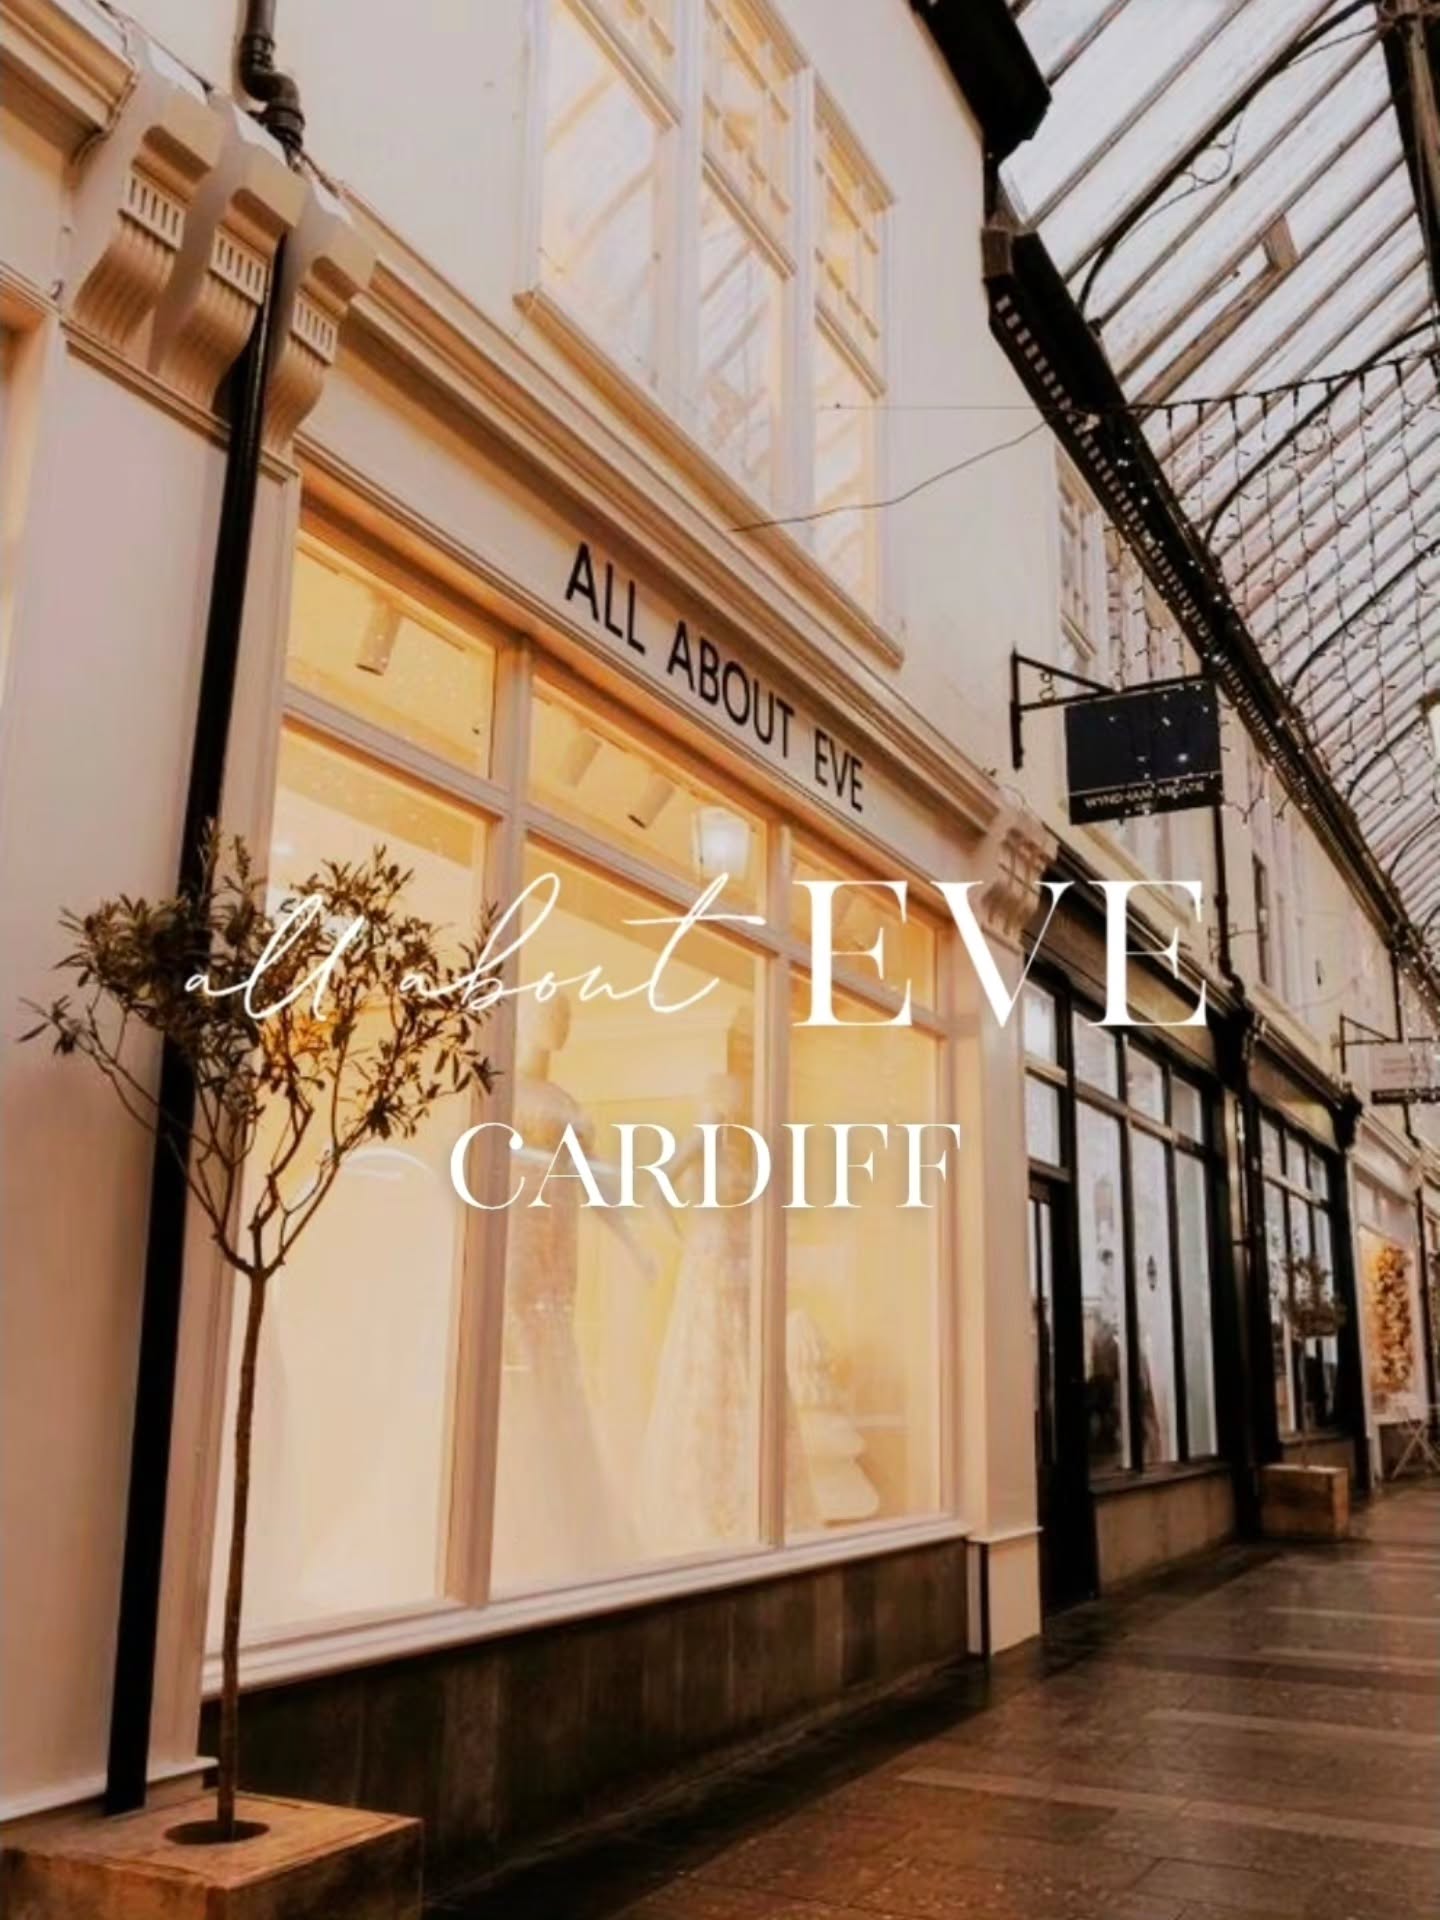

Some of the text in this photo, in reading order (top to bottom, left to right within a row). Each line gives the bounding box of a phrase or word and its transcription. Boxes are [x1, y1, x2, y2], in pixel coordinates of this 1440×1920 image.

[565, 542, 864, 812] ALL ABOUT EVE
